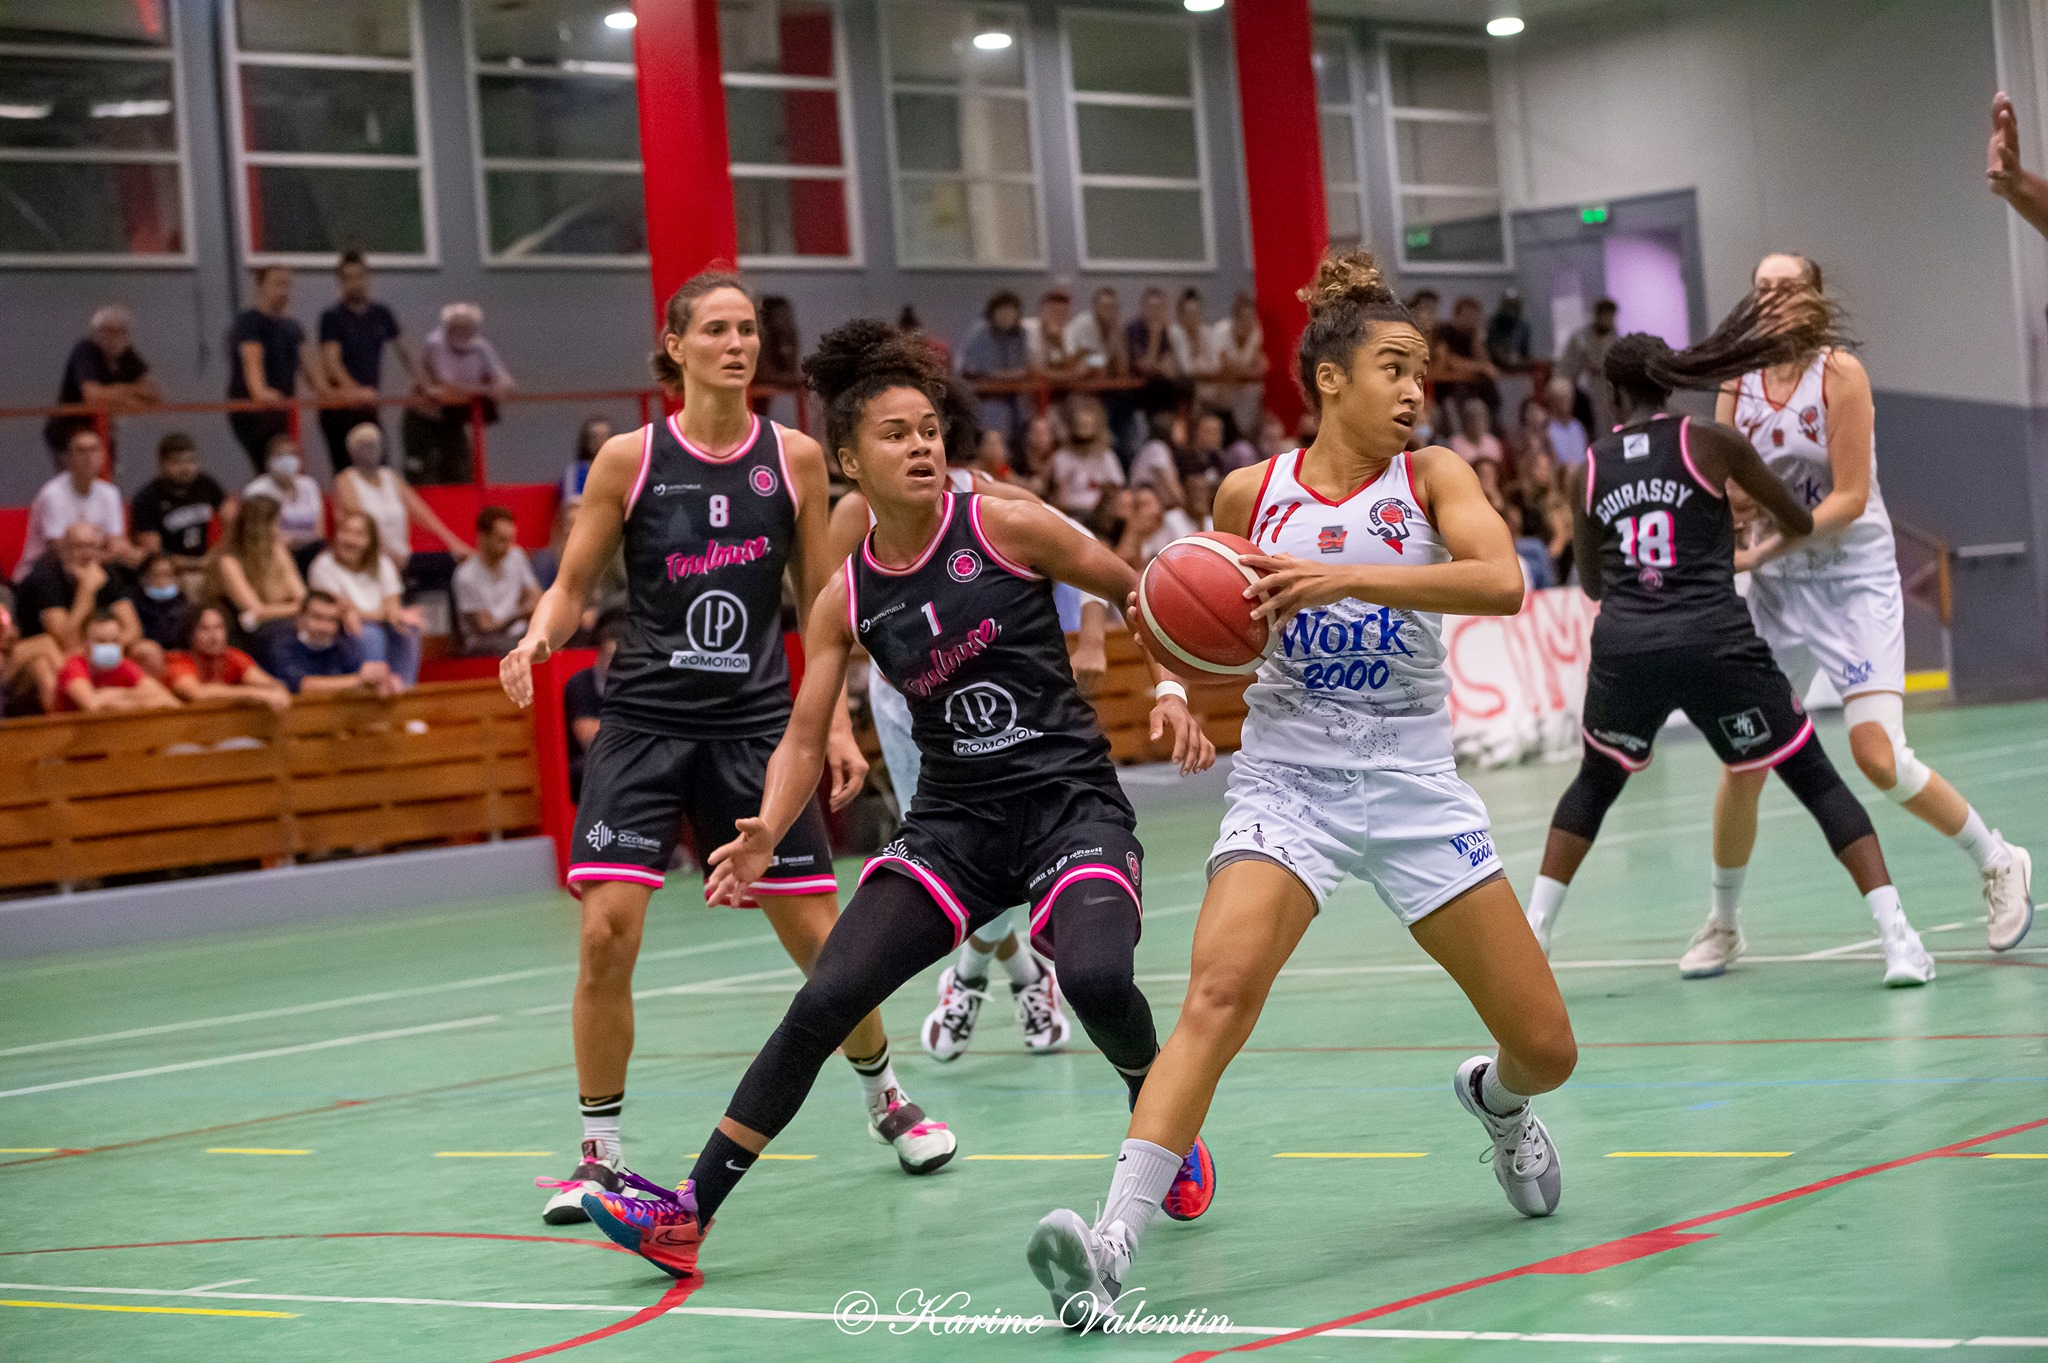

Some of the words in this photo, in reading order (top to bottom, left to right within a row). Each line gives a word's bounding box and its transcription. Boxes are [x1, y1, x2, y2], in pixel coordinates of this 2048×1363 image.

[710, 494, 730, 528] 8
[1595, 477, 1694, 526] GUIRASSY
[664, 535, 771, 584] Toulouse
[1615, 510, 1677, 568] 18
[921, 601, 943, 637] 1
[1282, 607, 1414, 659] Work
[674, 654, 748, 669] PROMOTION
[1303, 660, 1390, 691] 2000
